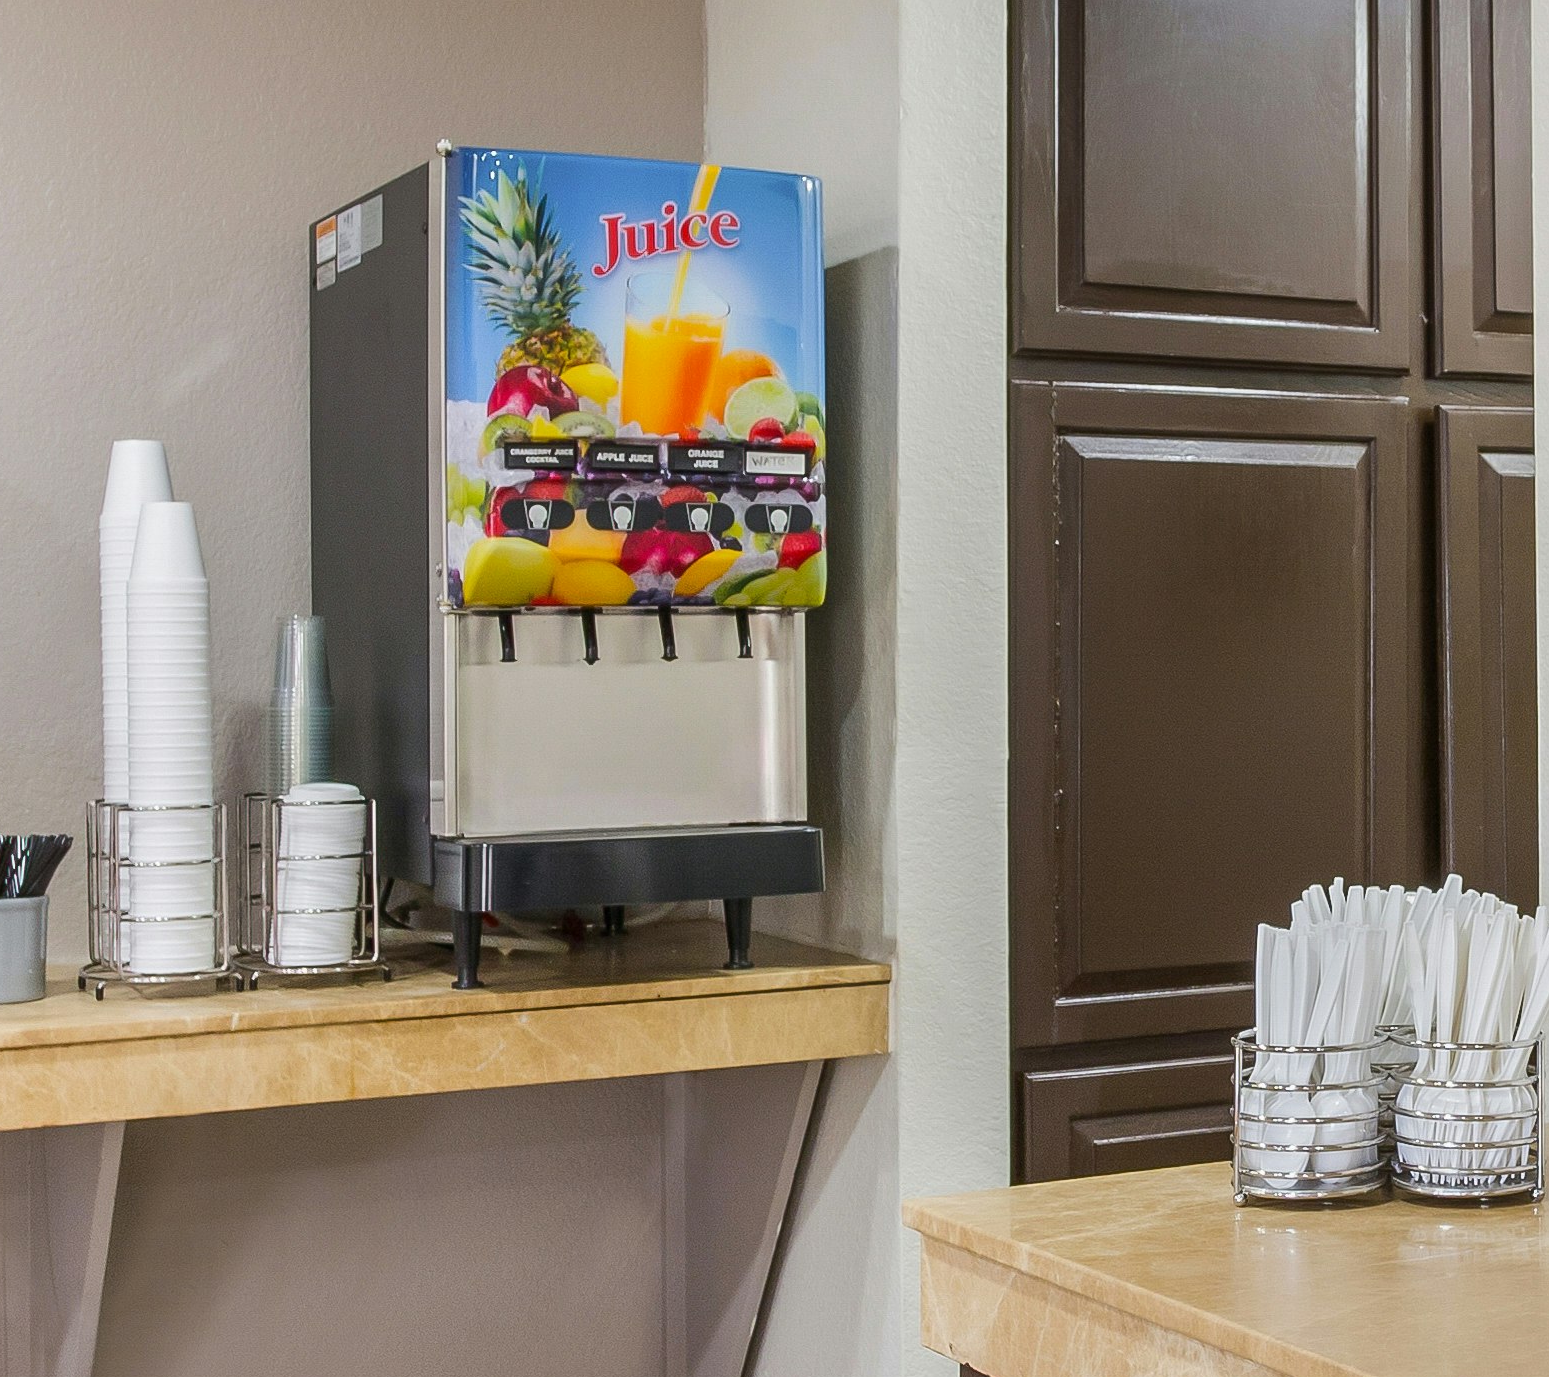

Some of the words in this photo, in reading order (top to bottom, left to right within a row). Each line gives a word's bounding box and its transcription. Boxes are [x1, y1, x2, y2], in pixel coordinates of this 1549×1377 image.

[593, 203, 740, 276] Juice
[596, 452, 625, 462] APPLE
[629, 454, 653, 463] JUICE
[688, 449, 724, 458] ORANGE
[694, 460, 719, 468] JUICE
